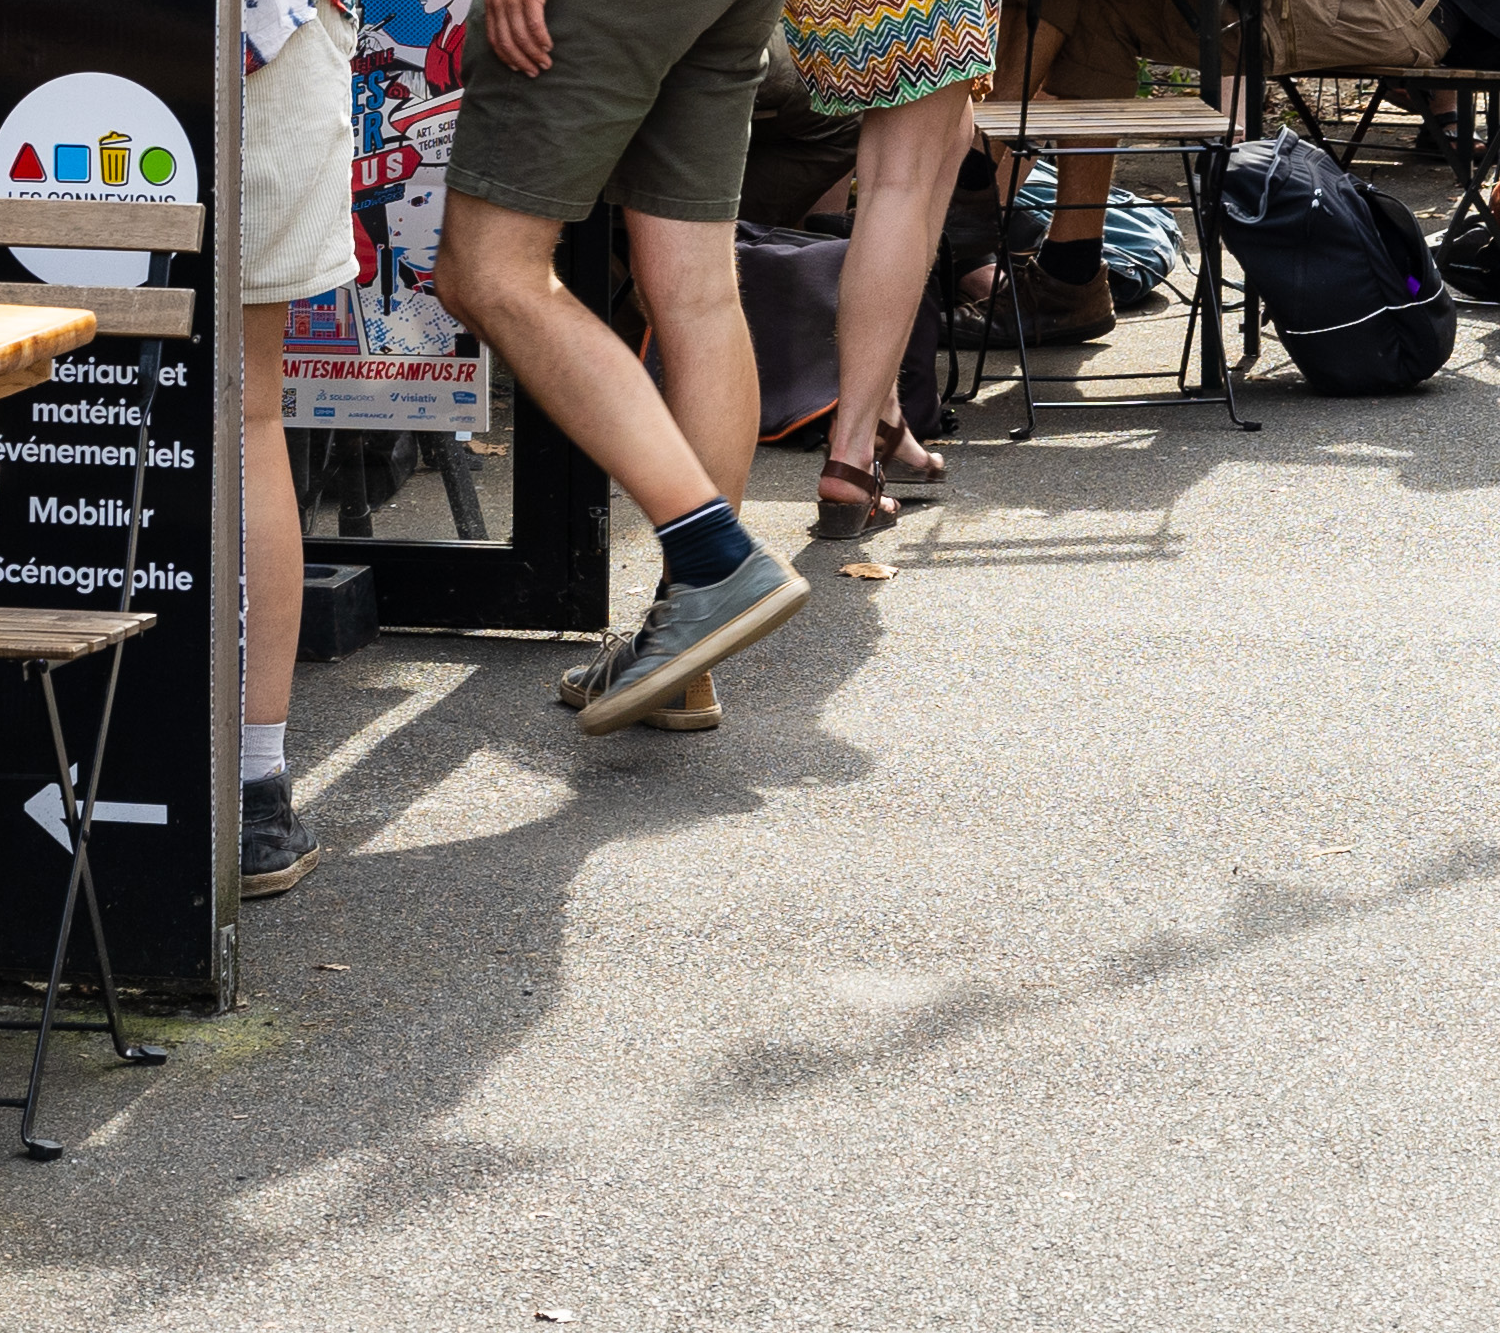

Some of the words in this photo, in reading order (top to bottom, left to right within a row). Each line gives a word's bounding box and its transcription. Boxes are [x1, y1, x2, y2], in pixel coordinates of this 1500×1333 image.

[49, 357, 138, 387] tériau
[158, 363, 187, 387] et
[282, 359, 477, 383] ANTESMAKERCAMPUS.FR
[401, 393, 437, 403] visiativ
[32, 399, 151, 427] matérie
